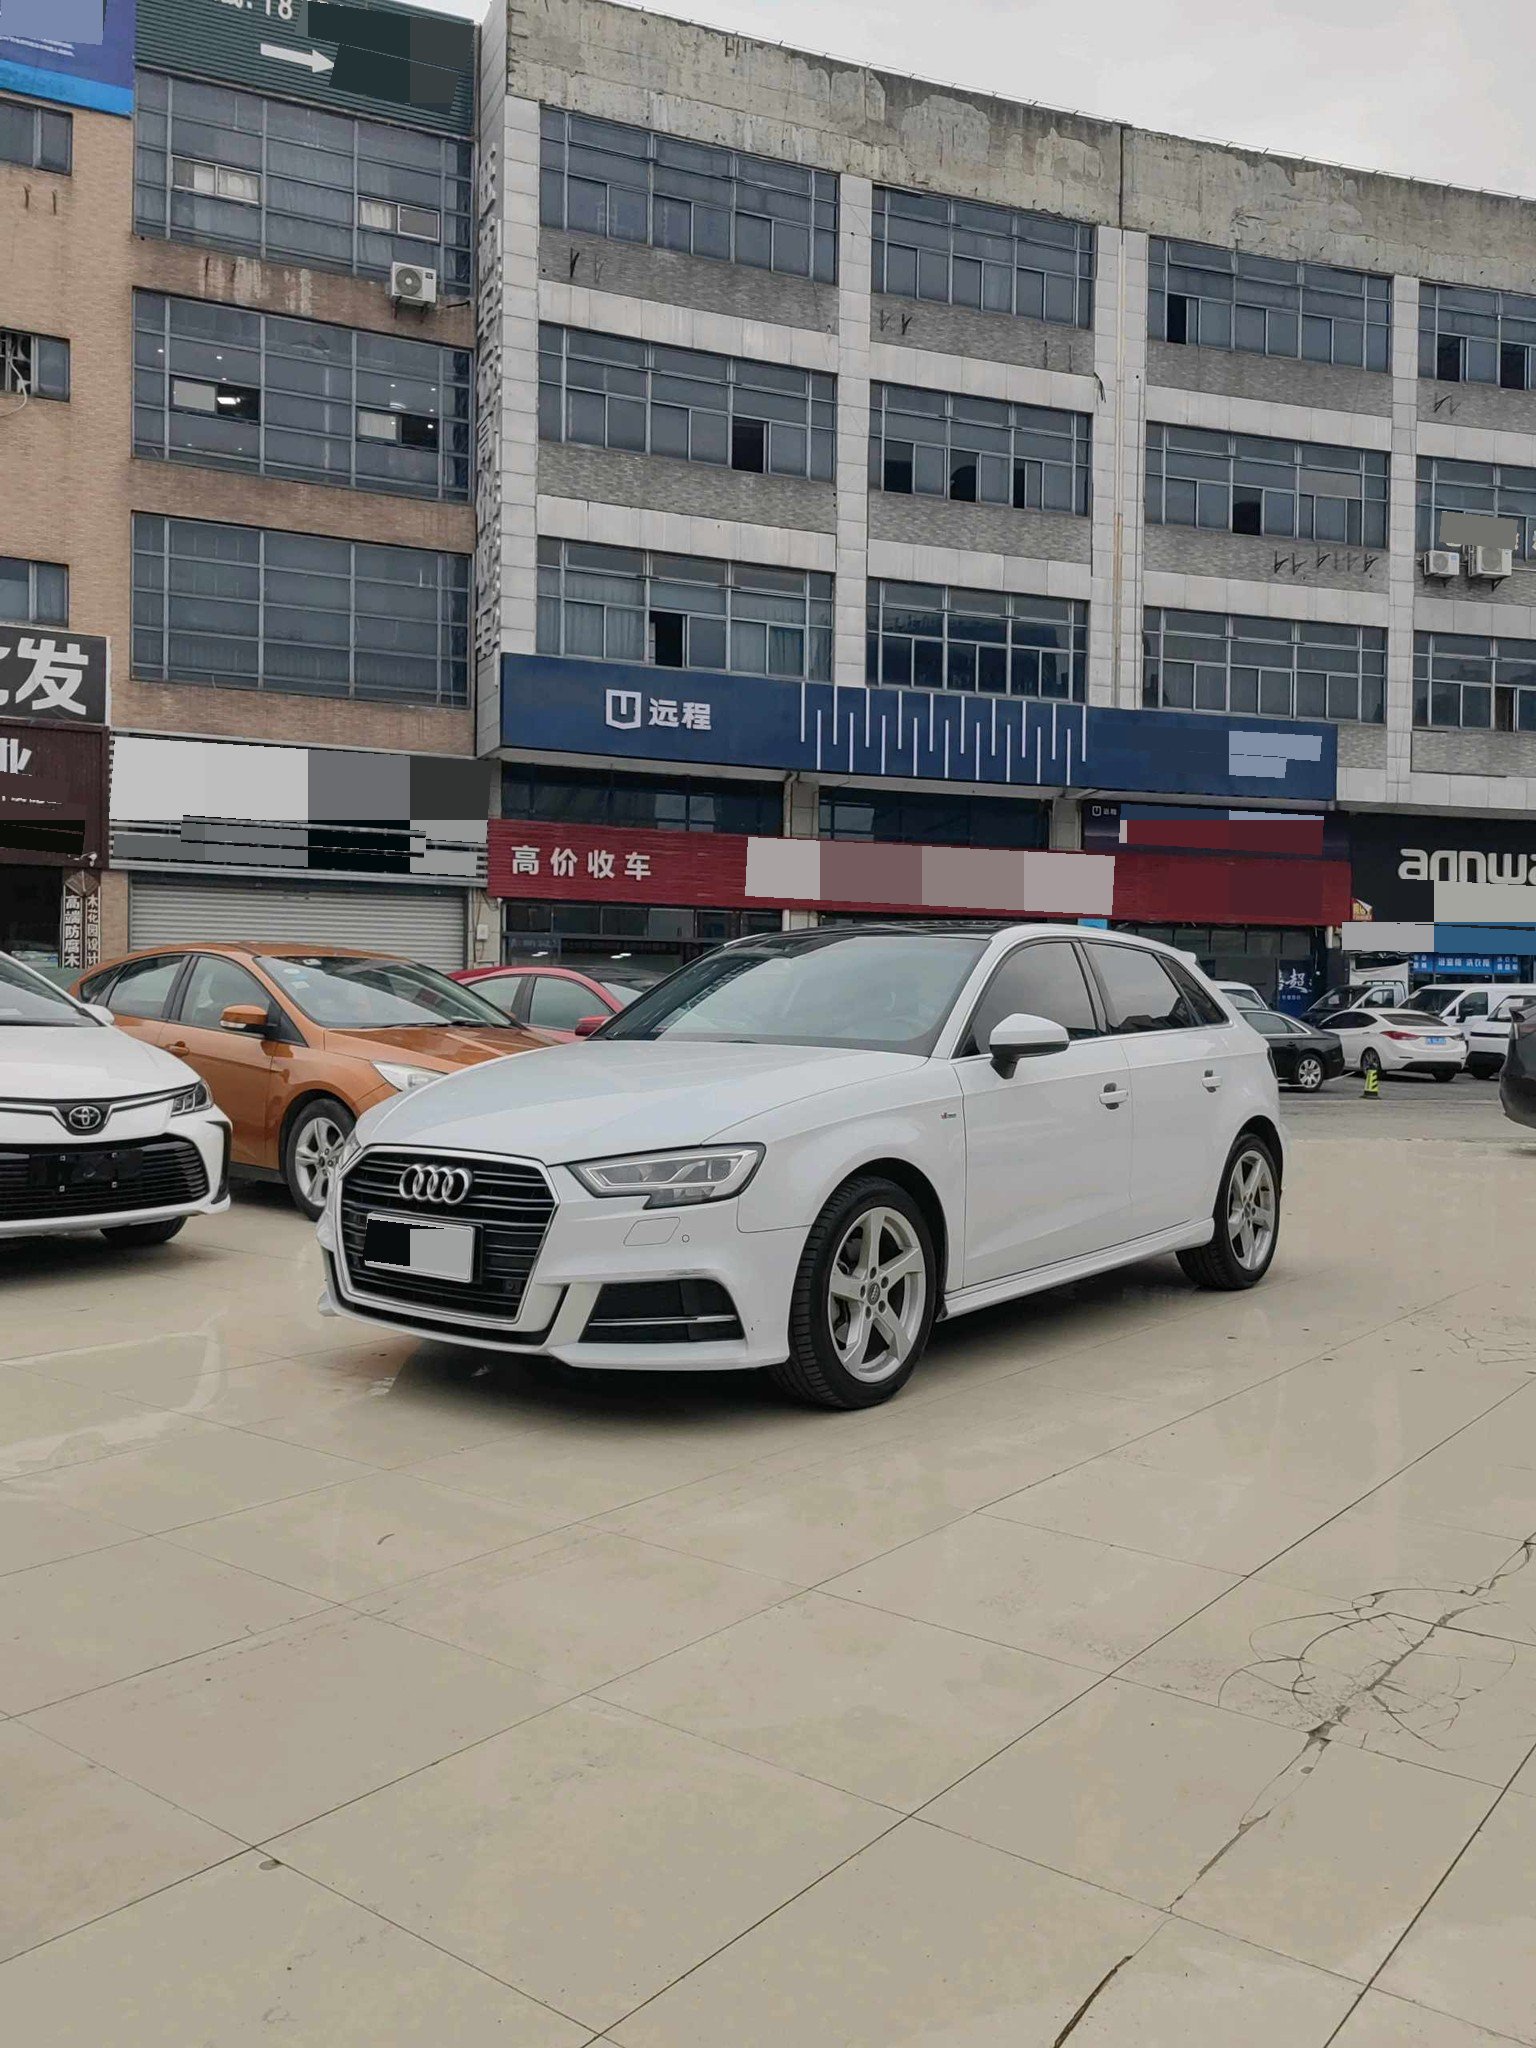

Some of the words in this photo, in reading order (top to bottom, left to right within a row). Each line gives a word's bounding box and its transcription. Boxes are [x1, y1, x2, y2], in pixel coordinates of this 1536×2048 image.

[0, 637, 89, 715] 发
[648, 697, 712, 731] 远程
[511, 844, 652, 881] 高价收车
[1397, 848, 1536, 887] annw
